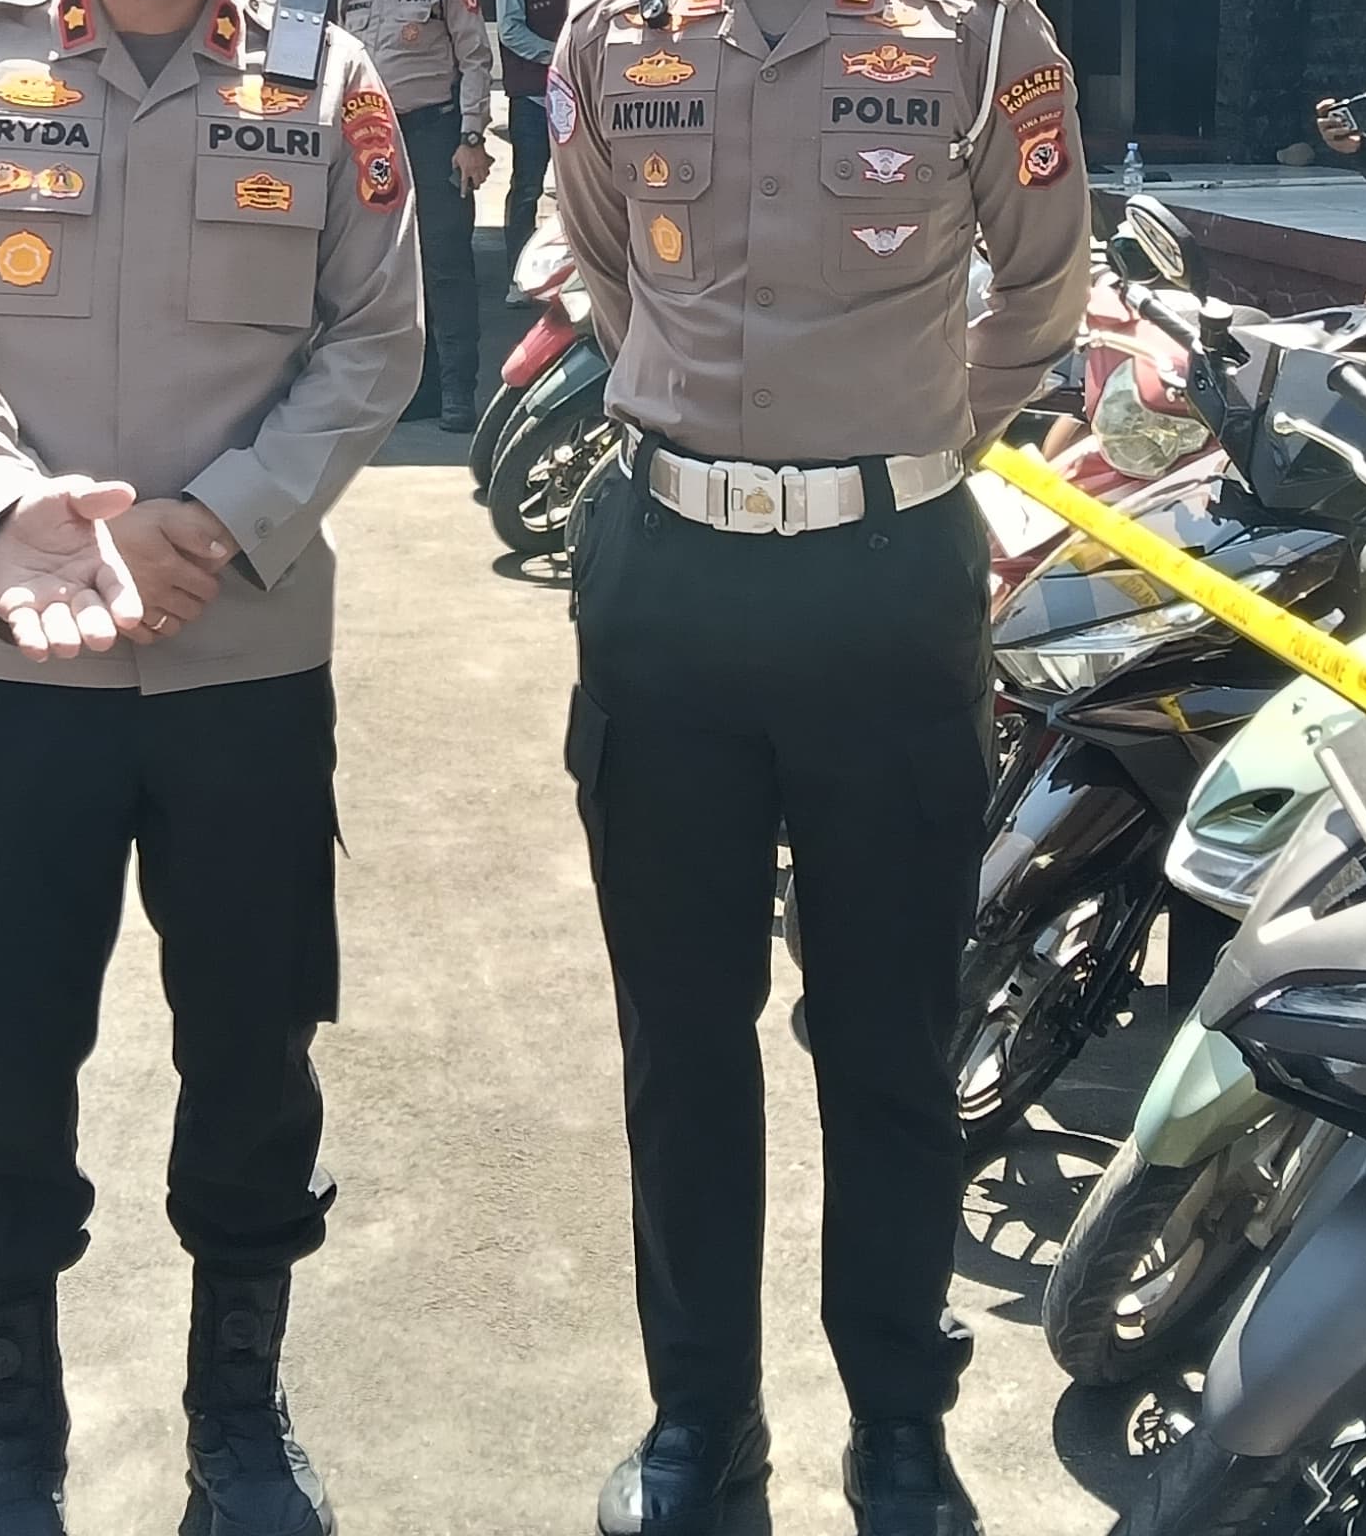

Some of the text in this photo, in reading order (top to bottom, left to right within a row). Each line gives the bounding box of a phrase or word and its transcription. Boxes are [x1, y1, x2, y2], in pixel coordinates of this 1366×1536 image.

[999, 69, 1062, 107] POLRES
[1006, 81, 1061, 115] KUNINGAN
[611, 101, 705, 132] AKTUIN.M
[832, 96, 940, 128] POLRI
[208, 122, 321, 159] POLRI
[1289, 630, 1349, 685] POLICE LINE
